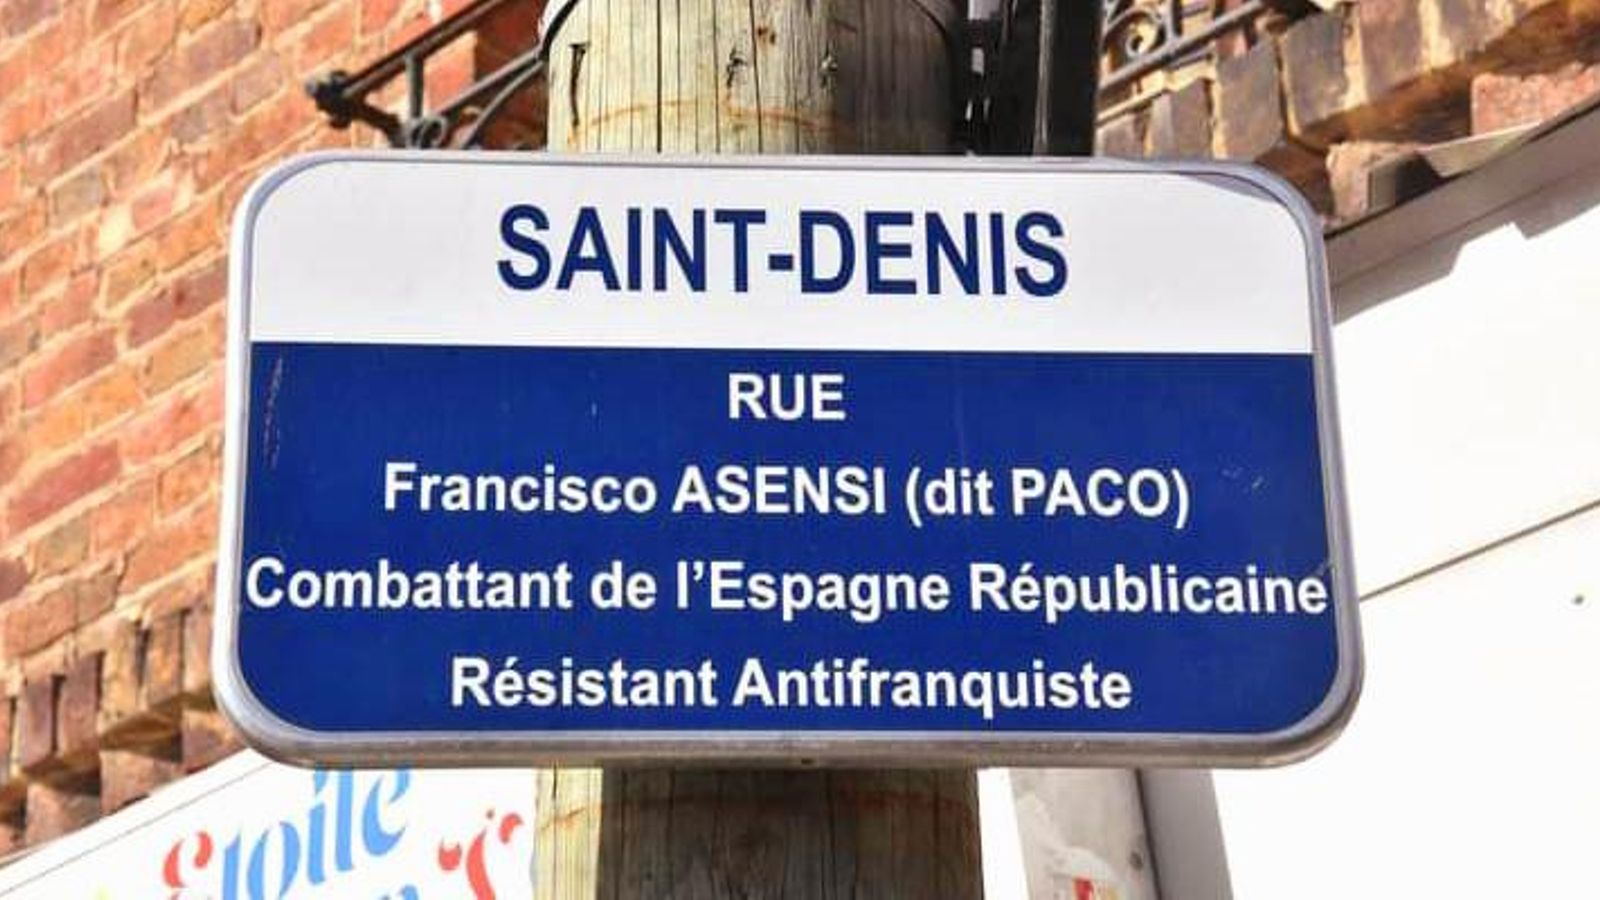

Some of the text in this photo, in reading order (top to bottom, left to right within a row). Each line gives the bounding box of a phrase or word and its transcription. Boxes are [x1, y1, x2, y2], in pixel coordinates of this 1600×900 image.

[497, 204, 1069, 298] SAINT-DENIS
[728, 373, 847, 421] RUE
[384, 462, 1190, 529] Francisco ASENSI (dit PACO)
[245, 557, 1328, 624] Combattant de l’Espagne Républicaine
[451, 656, 1132, 720] Résistant Antifranquiste
